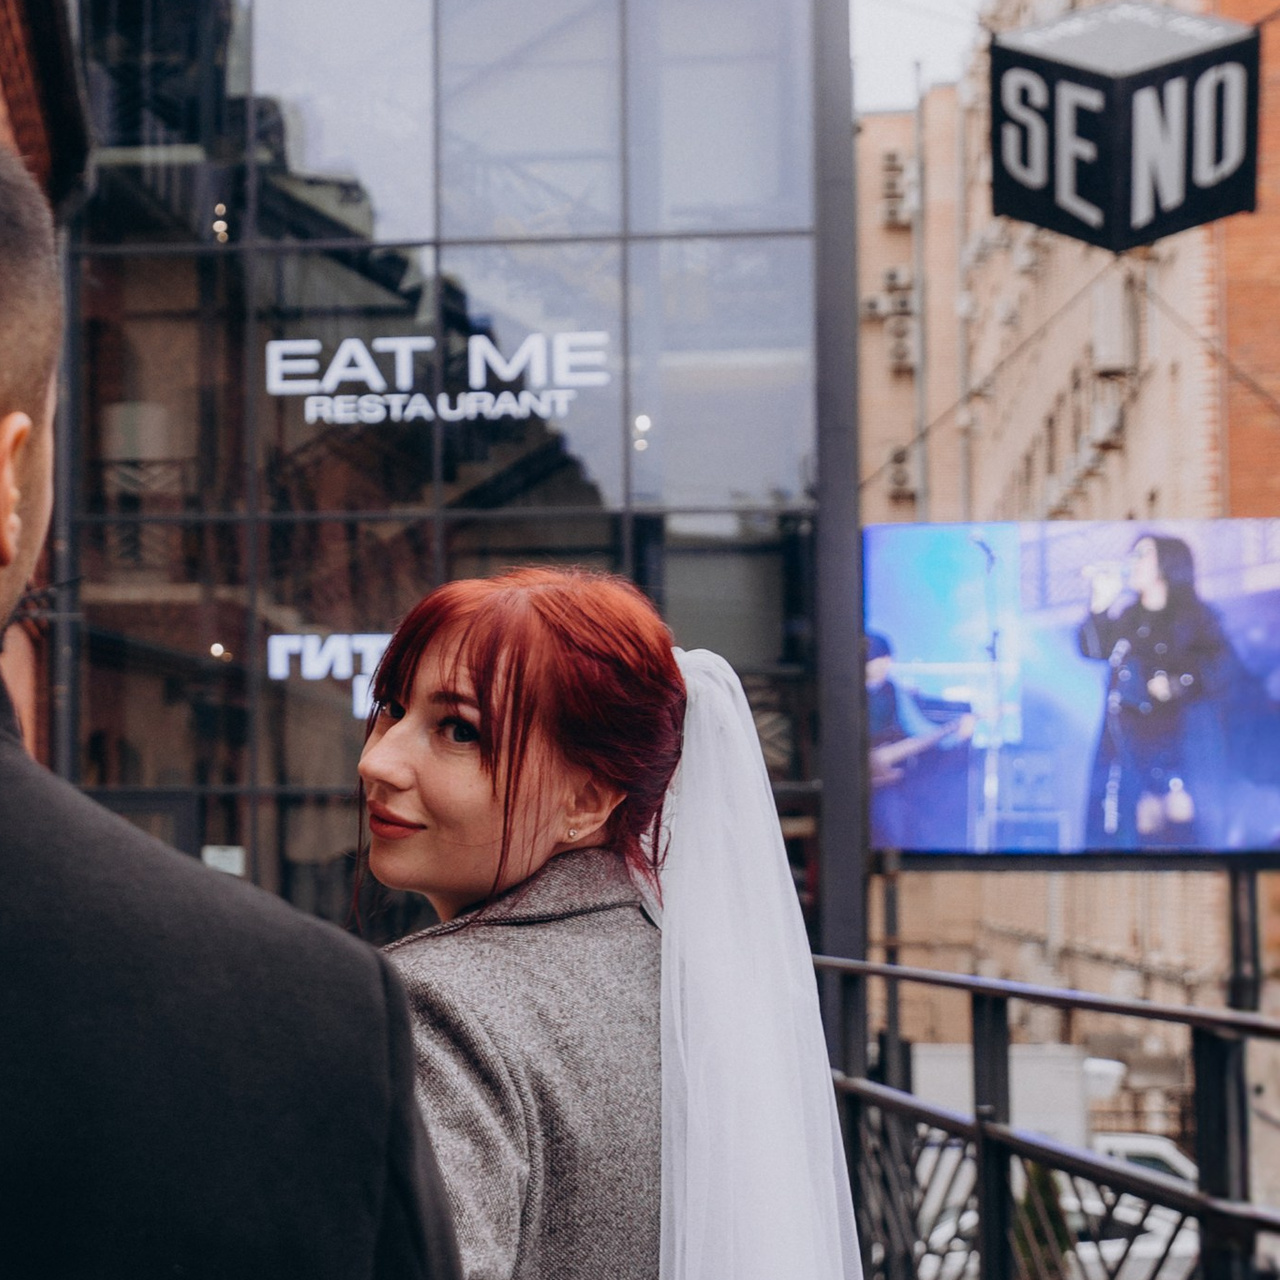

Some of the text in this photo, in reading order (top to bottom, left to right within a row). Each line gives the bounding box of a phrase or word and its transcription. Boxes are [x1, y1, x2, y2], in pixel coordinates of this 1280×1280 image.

[265, 330, 611, 396] EAT ME
[304, 388, 577, 424] RESTAURANT
